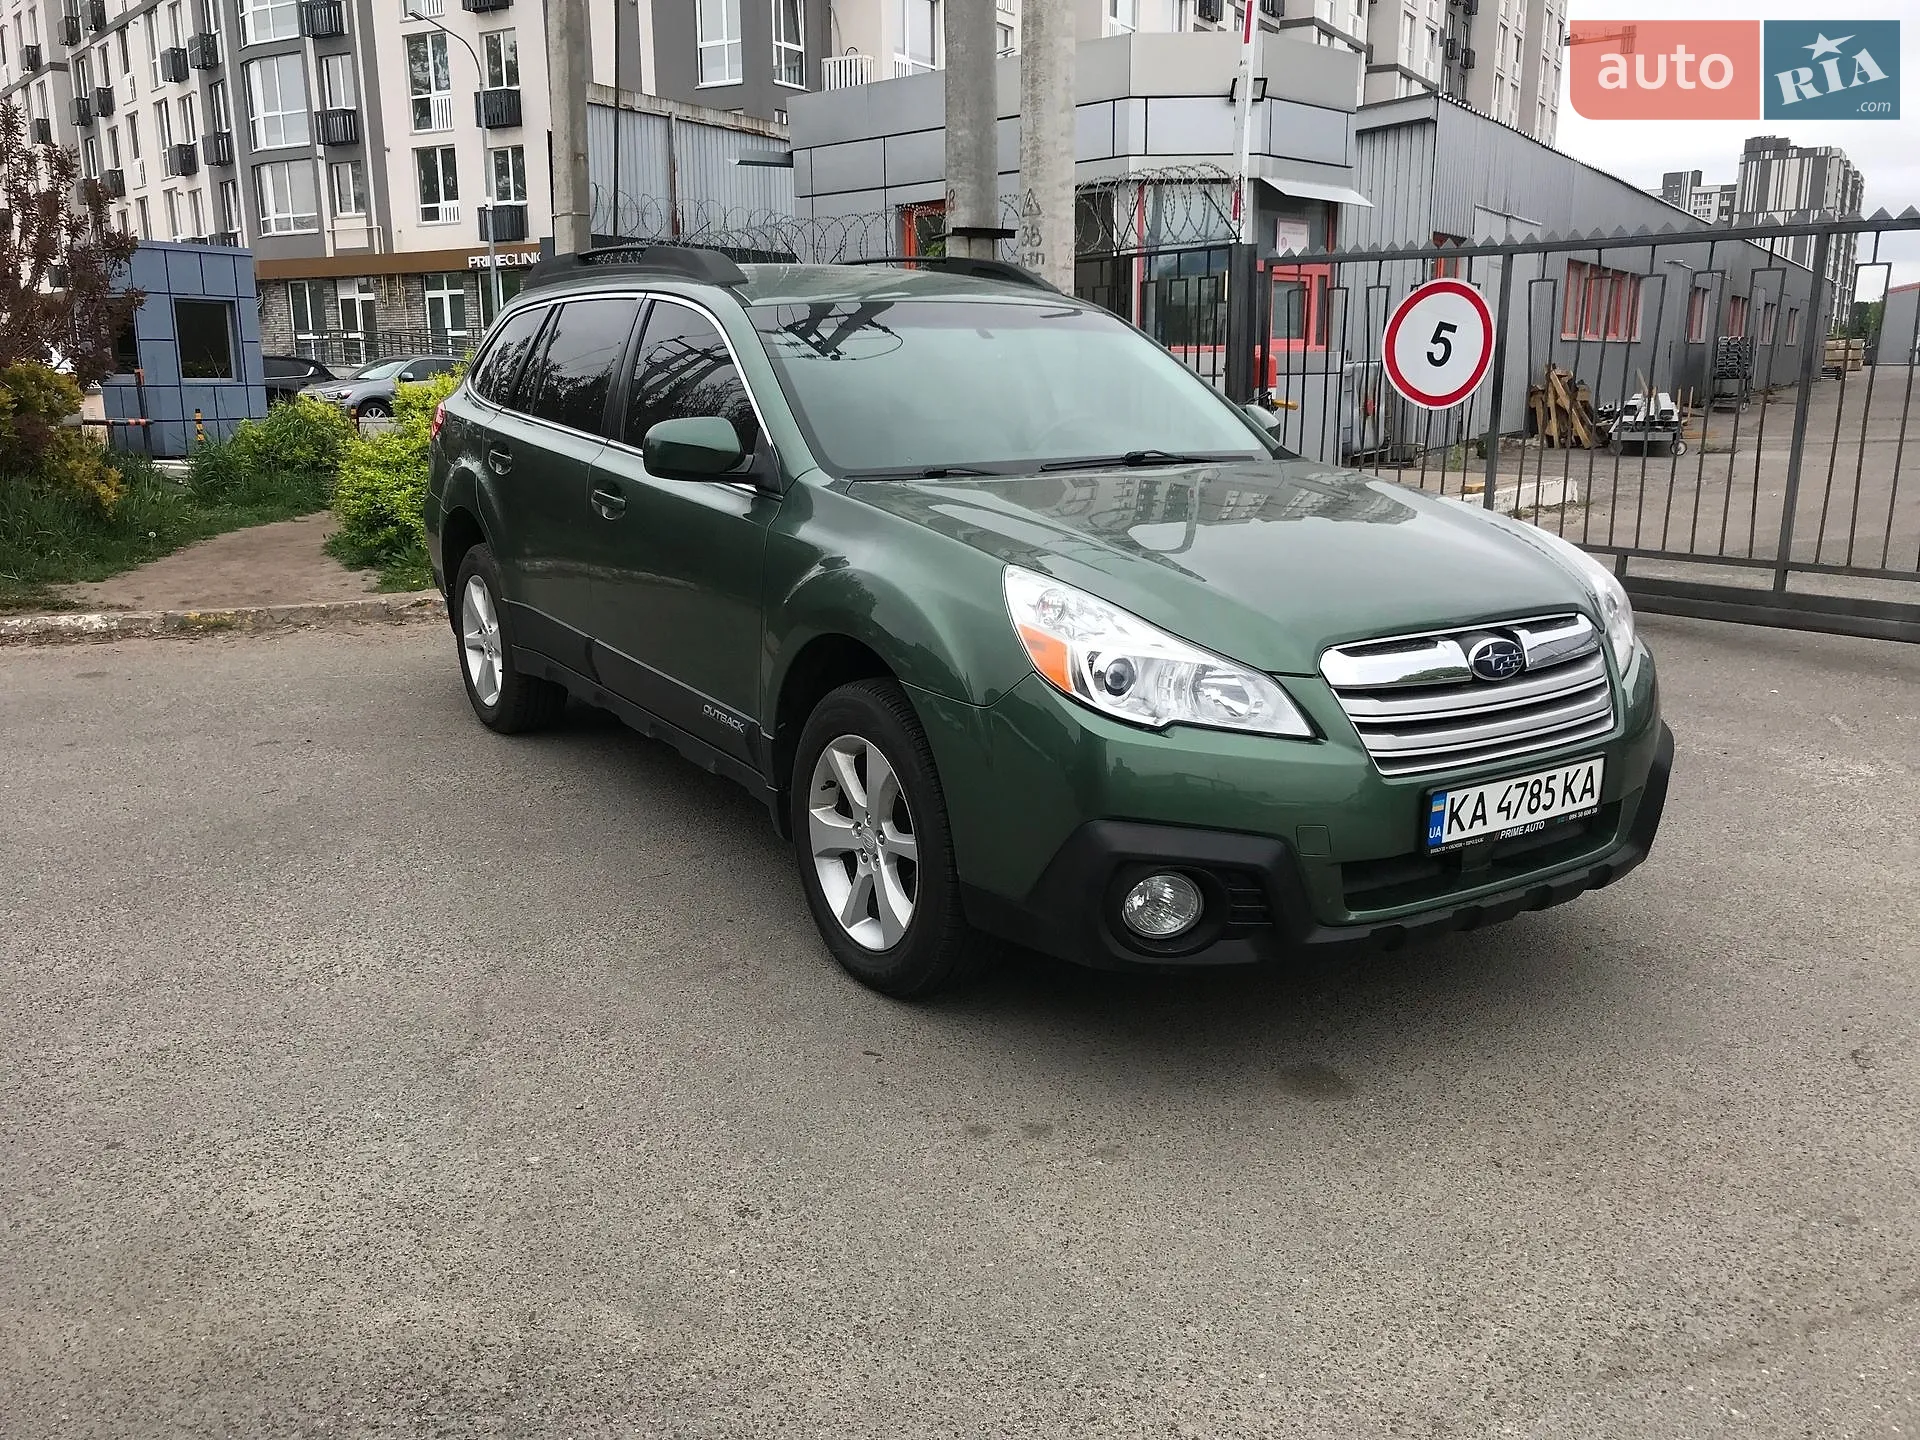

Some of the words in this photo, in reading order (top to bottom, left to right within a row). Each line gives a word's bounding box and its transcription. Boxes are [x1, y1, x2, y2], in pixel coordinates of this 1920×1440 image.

[1426, 320, 1458, 368] 5
[703, 704, 745, 733] OUTBACK
[1446, 791, 1488, 835] KA
[1496, 774, 1557, 821] 4785
[1561, 765, 1595, 808] KA
[1428, 826, 1442, 840] UA
[1500, 825, 1525, 840] PRIME
[1524, 820, 1546, 834] AUTO
